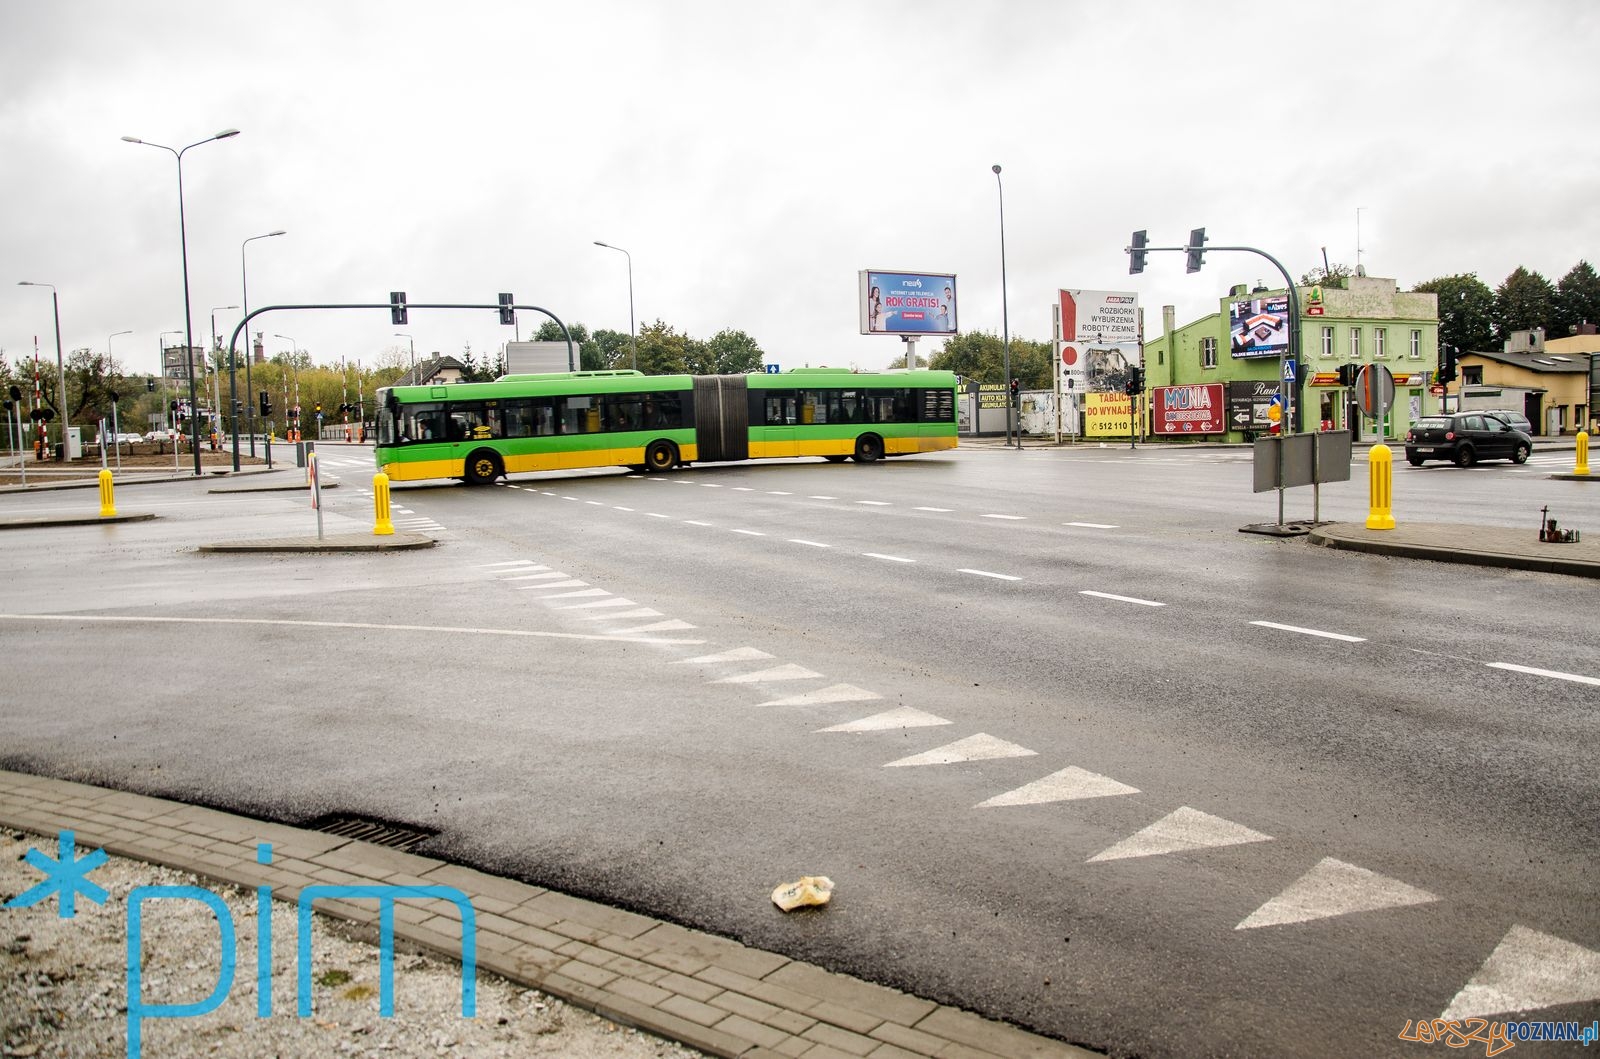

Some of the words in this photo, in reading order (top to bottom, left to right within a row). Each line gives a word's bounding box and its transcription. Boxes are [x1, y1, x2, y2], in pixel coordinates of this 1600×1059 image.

[886, 296, 904, 306] ROK
[906, 297, 939, 308] GRATIS!
[1100, 306, 1135, 315] ROZBIÓRKI
[1091, 315, 1134, 324] WYBURZENIA
[1252, 382, 1279, 395] Raut
[1164, 386, 1212, 410] MYJNIA
[1088, 407, 1098, 416] DO
